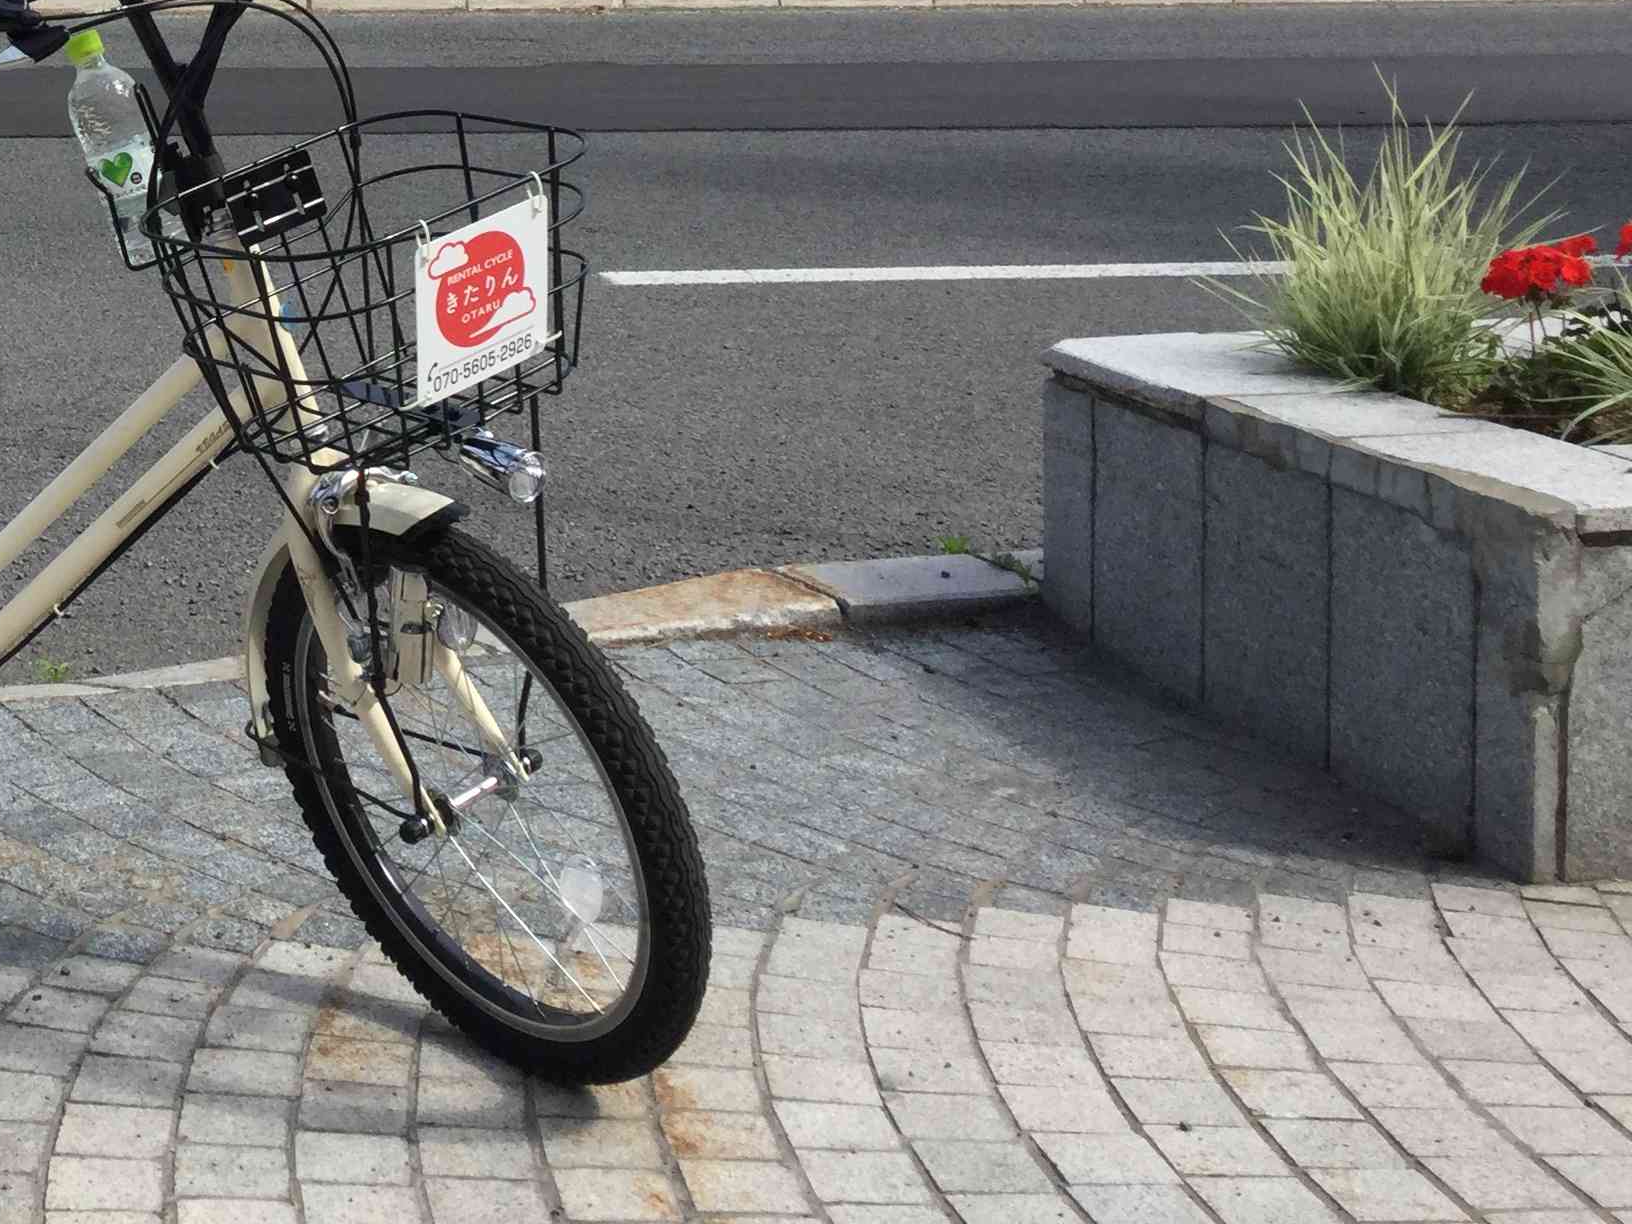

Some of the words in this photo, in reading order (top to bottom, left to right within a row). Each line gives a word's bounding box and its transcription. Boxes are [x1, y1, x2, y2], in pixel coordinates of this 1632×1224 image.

[447, 264, 483, 287] RENTAL
[484, 249, 514, 269] CYCLE
[446, 267, 519, 315] きたりん
[461, 299, 502, 324] OTARU
[433, 333, 533, 393] 070-5605-2926
